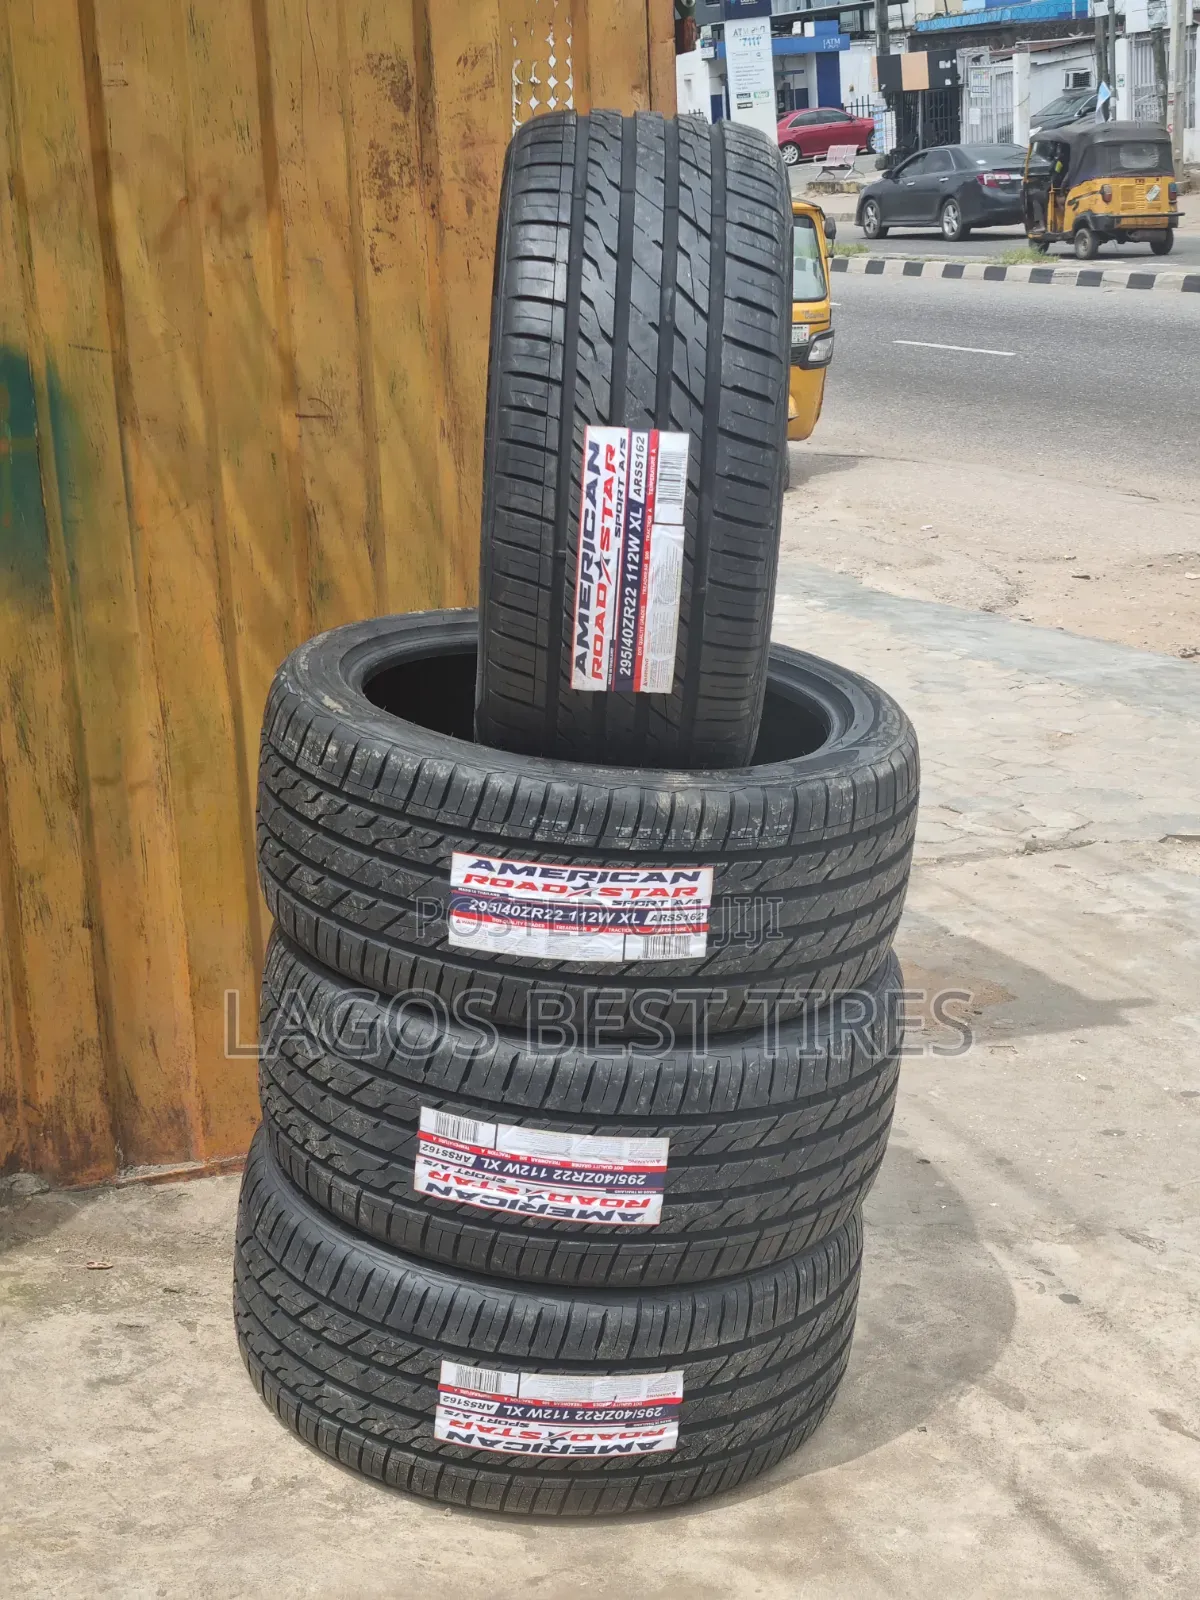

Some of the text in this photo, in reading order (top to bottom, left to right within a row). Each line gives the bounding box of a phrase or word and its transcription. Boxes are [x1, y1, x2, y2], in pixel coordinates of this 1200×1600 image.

[614, 477, 624, 538] SPORT
[576, 440, 600, 676] AMERICAN
[591, 444, 616, 680] ROAD STAR
[620, 436, 644, 676] 295/40ZR22 112W XL ARSS162
[468, 859, 702, 885] AMERICAN
[463, 874, 698, 898] ROAD STAR
[468, 900, 704, 924] 295/40ZR22 112W XL ARSS162
[422, 1144, 472, 1163] ARSS162
[488, 1149, 510, 1158] TRACTION
[423, 1160, 506, 1184] SPORT A/S
[480, 1158, 646, 1185] 295/40ZR22 112W XL
[428, 1170, 650, 1208] ROAD STAR
[425, 1182, 646, 1222] AMERICAN
[443, 1396, 494, 1410] ARSS162
[503, 1406, 663, 1420] 295/40ZR22 112W XL
[444, 1410, 530, 1428] SPORT A/S
[448, 1420, 668, 1442] ROAD STAR
[446, 1431, 662, 1454] AMERICAN
